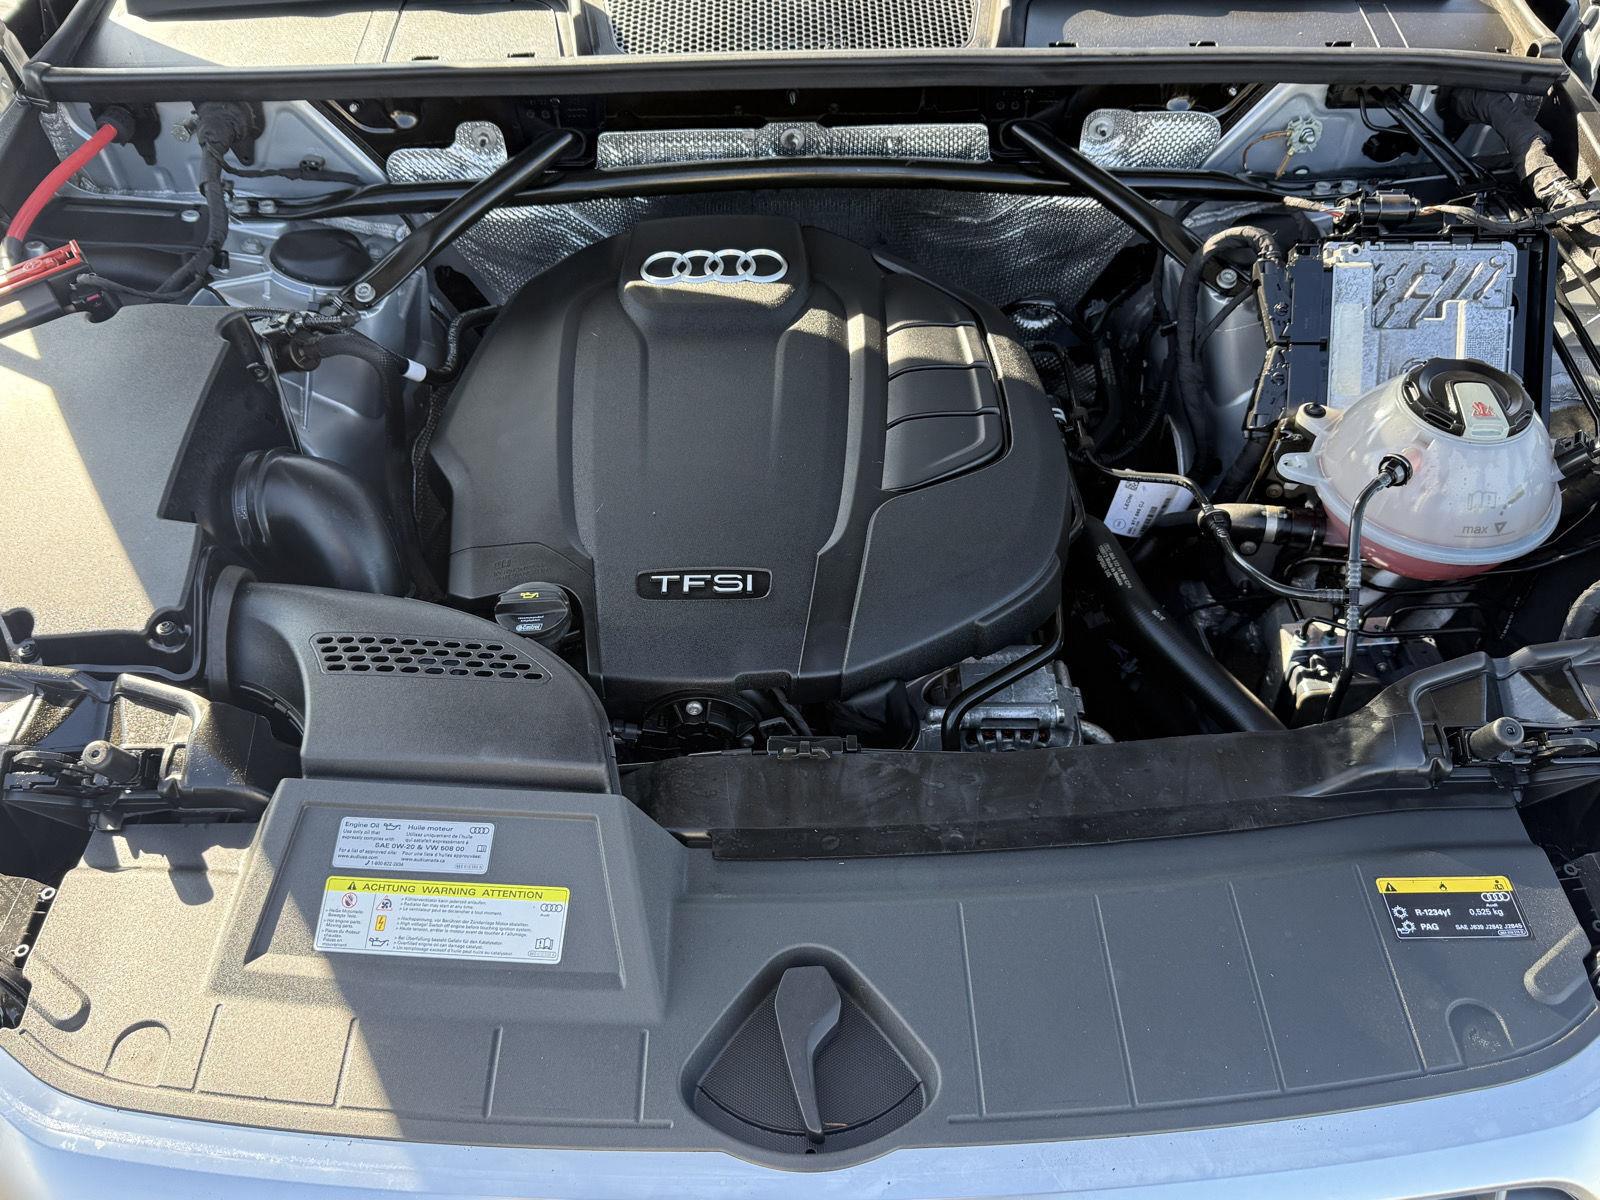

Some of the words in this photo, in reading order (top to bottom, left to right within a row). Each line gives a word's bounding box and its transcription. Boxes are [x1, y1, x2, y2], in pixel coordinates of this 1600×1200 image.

[1462, 526, 1488, 534] max
[651, 574, 753, 594] TFSI
[363, 884, 416, 893] ACHTUNG
[422, 886, 476, 896] WARNING
[482, 889, 543, 900] ATTENTION
[1414, 908, 1451, 917] R-1234yf
[1468, 908, 1492, 916] 0,525
[1492, 908, 1504, 916] kg
